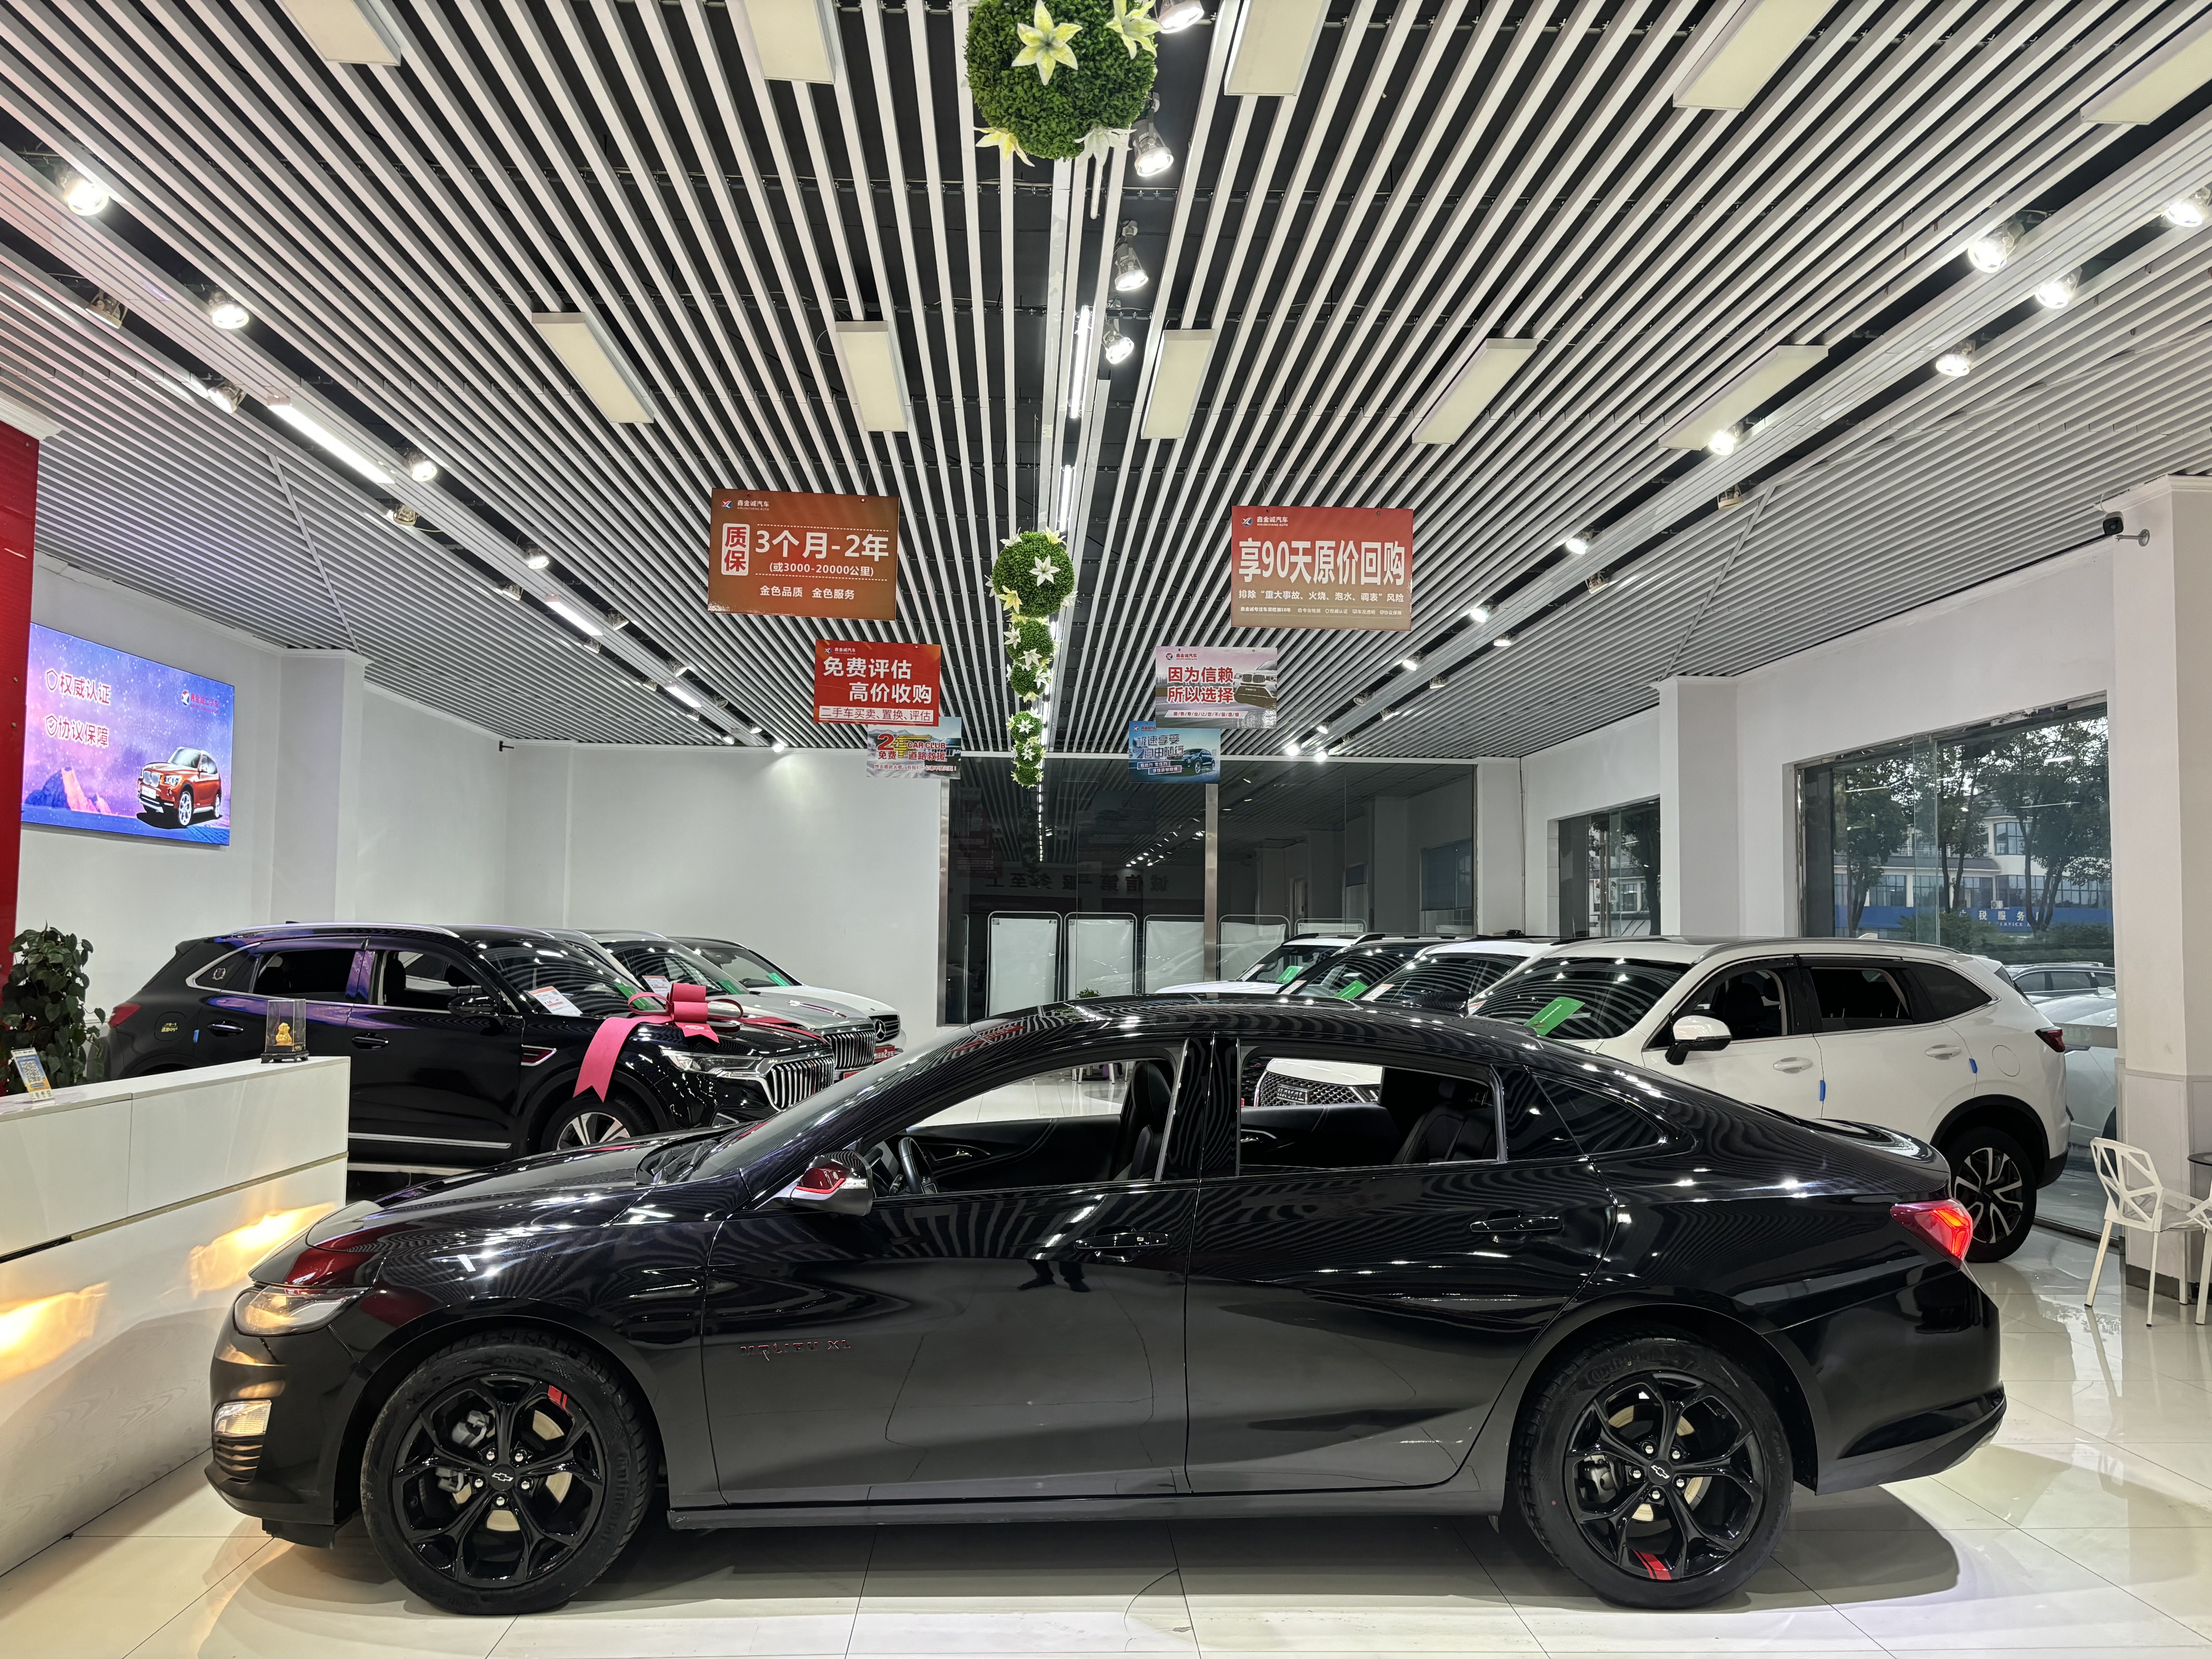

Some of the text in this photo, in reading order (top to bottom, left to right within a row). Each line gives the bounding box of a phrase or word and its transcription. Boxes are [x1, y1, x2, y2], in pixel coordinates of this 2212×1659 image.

[737, 499, 769, 507] 鑫金诚汽车
[724, 527, 747, 572] 质保
[756, 530, 889, 562] 3个月-2年
[769, 563, 874, 577] (或3000-20000公里)
[1239, 538, 1405, 586] 享90天原价回购
[760, 586, 855, 599] 金色品质 金色服务
[823, 656, 912, 679] 免费评估
[1168, 666, 1233, 683] 因为信赖
[60, 672, 110, 704] 权威认证
[849, 682, 932, 704] 高价收购
[1168, 686, 1233, 703] 所以选择
[821, 708, 930, 721] 二手车买卖、置换、评估
[59, 717, 109, 747] 协议保障
[879, 751, 945, 761] 免费 道路救援
[1145, 746, 1184, 758] 自由随行
[1278, 1088, 1304, 1101] HAVAL
[740, 1340, 851, 1355] MALIBU XL
